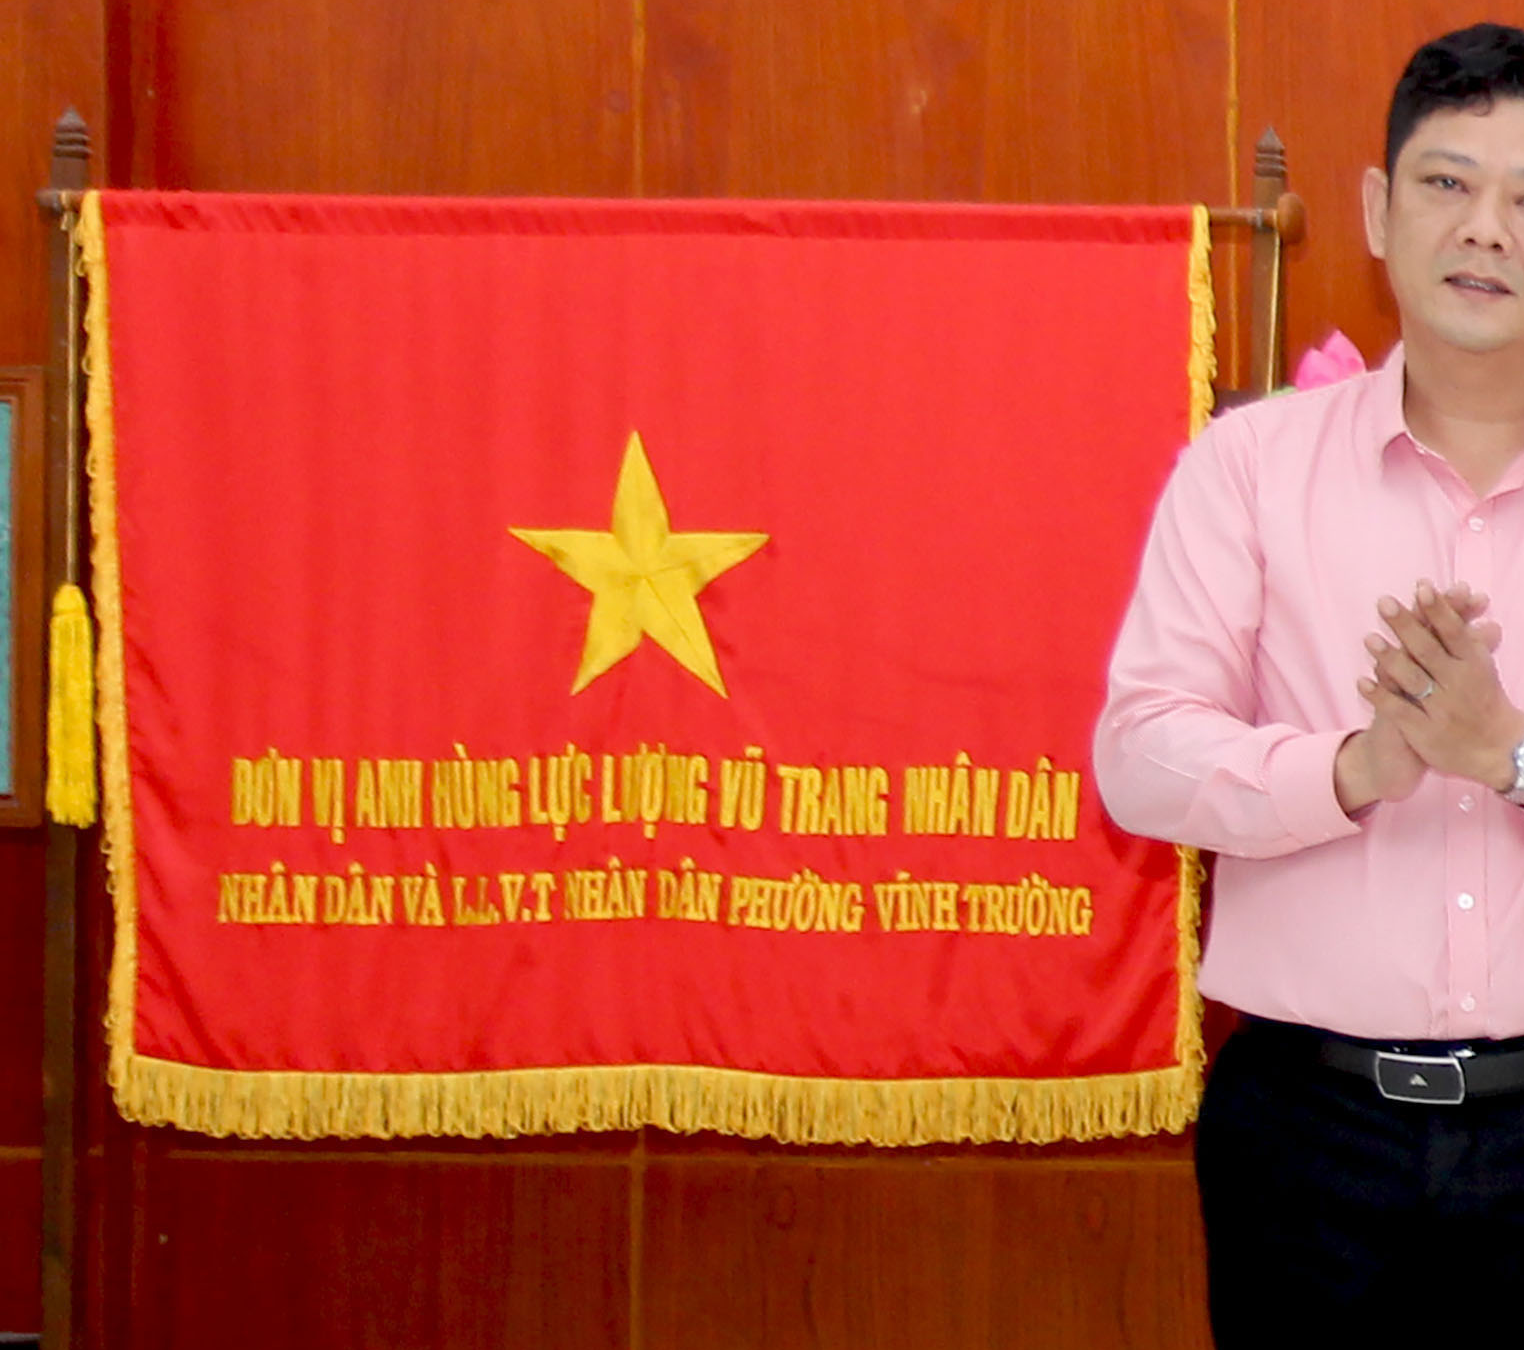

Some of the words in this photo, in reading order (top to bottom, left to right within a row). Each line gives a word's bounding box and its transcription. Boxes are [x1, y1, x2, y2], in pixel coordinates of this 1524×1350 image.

[311, 757, 346, 845] VỊ
[356, 759, 423, 827] ANH
[432, 742, 521, 828] HÙNG
[529, 743, 592, 842] LỰC
[603, 742, 708, 839] LƯỢNG
[719, 745, 767, 831] VŨ
[777, 764, 890, 836] TRANG
[904, 750, 999, 838] NHÂN
[1006, 756, 1080, 840] DÂN
[217, 860, 318, 924] NHÂN
[324, 861, 395, 925] DÂN
[401, 861, 446, 925] VÀ
[563, 855, 648, 920] NHÂN
[656, 856, 722, 922] DÂN
[727, 867, 866, 933] PHƯỜNG
[873, 869, 960, 931] VĨNH
[965, 871, 1094, 936] TRƯỜNG
